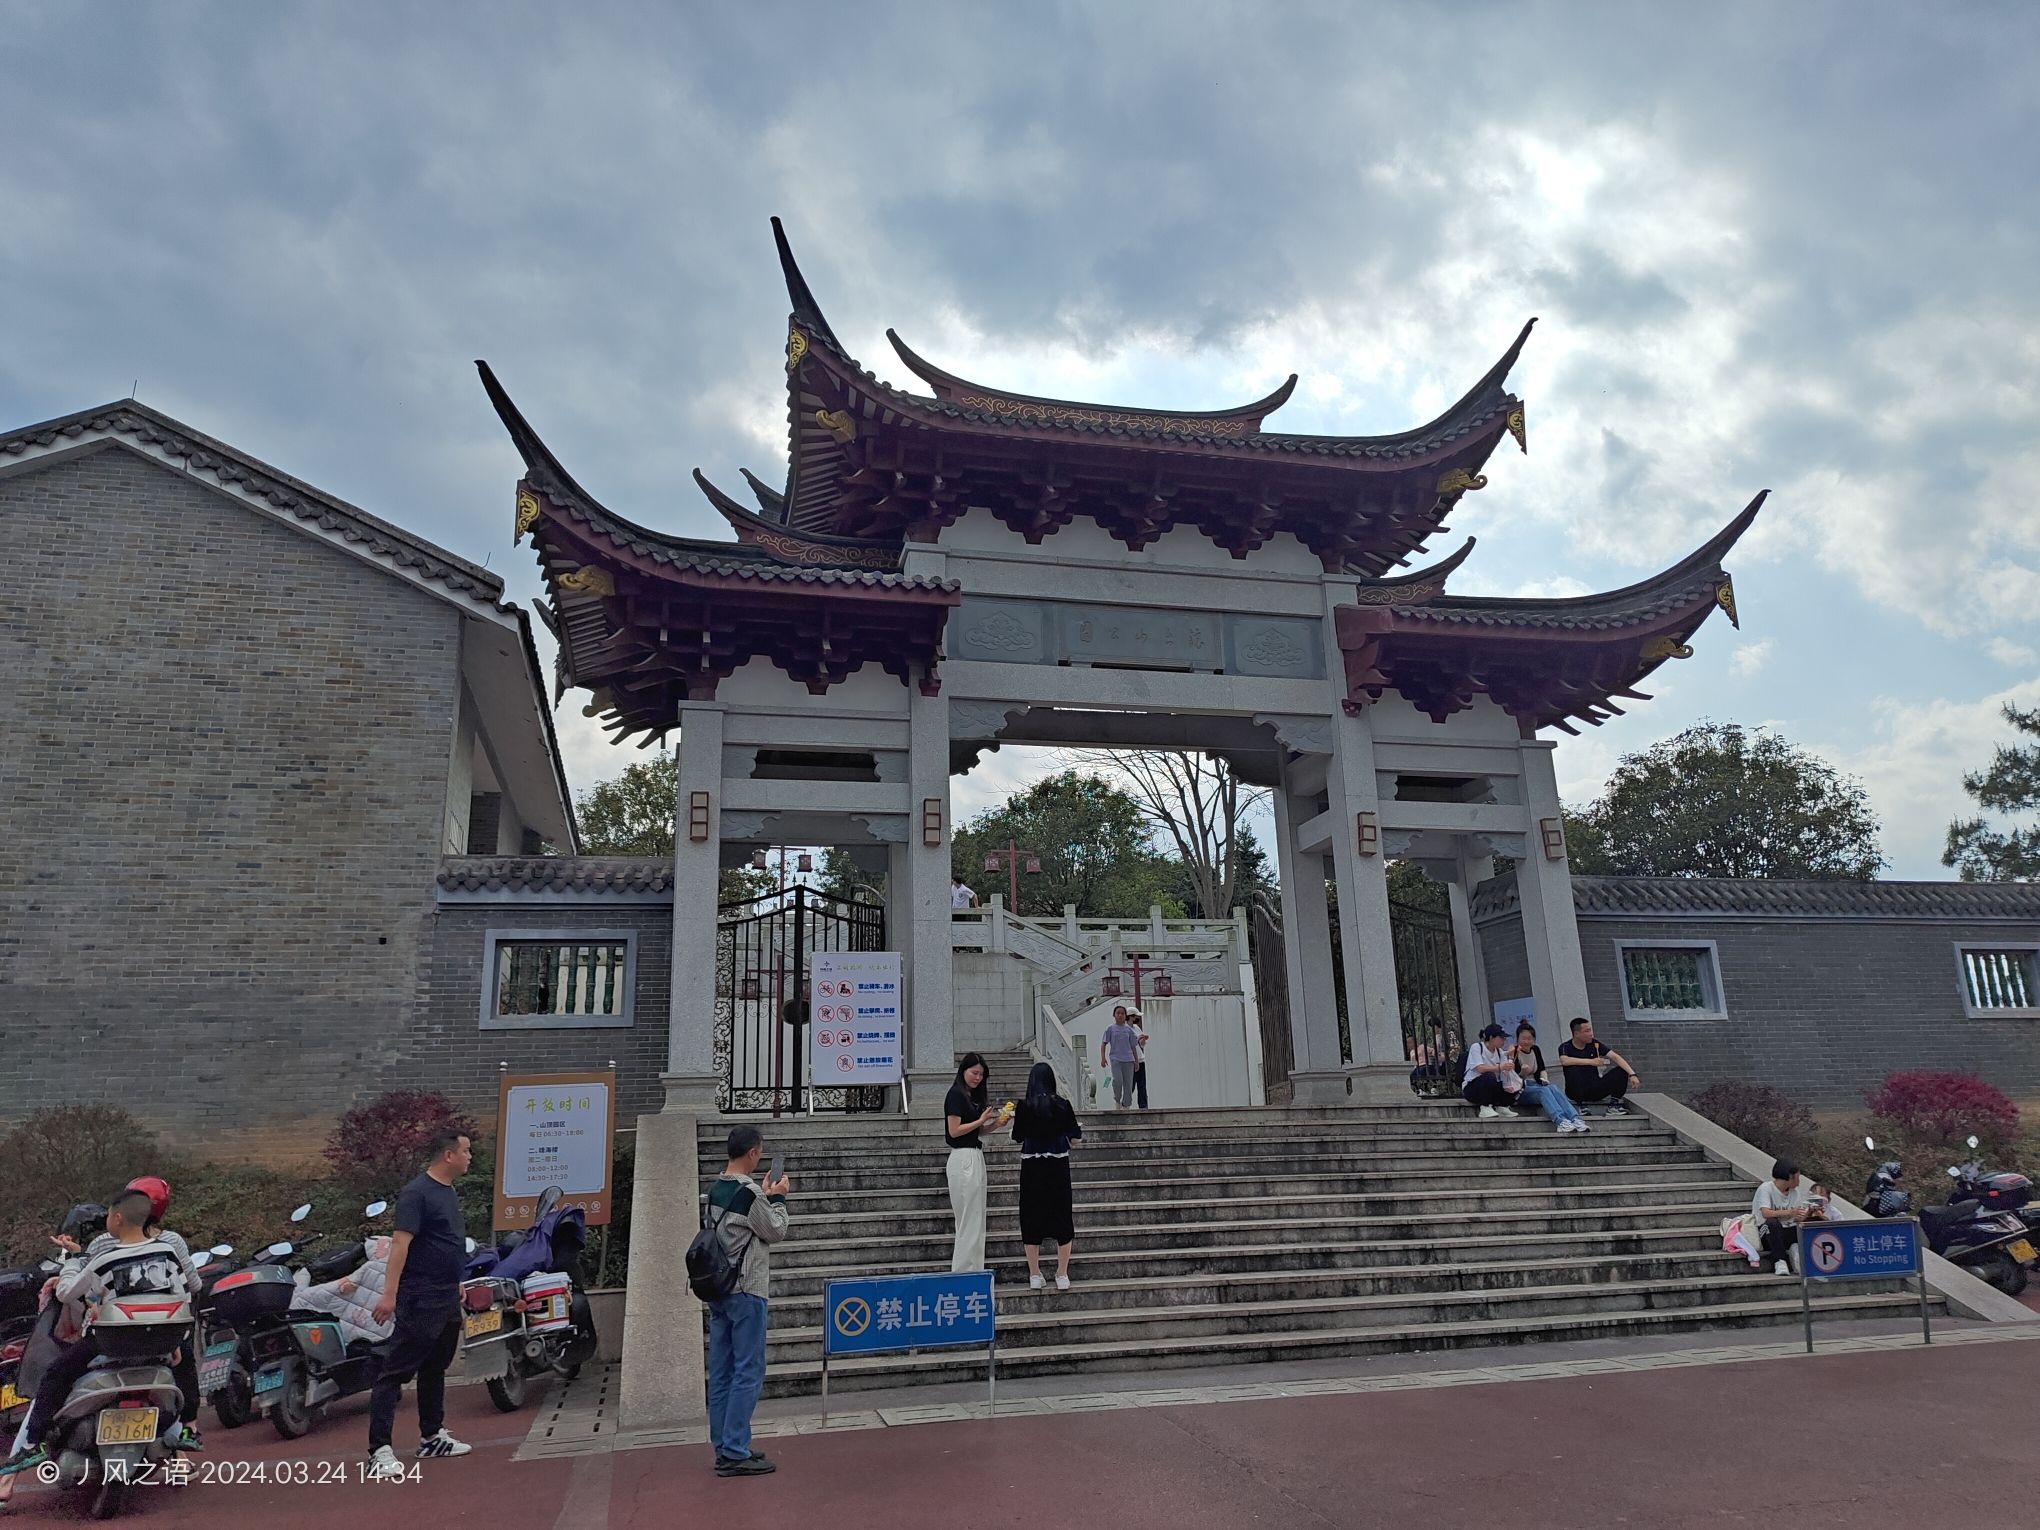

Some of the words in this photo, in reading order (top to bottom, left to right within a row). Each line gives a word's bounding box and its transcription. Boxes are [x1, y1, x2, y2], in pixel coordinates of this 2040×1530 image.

[524, 1097, 591, 1114] 开放时间
[1853, 1234, 1908, 1253] 禁止停车
[1854, 1256, 1866, 1265] No
[1868, 1253, 1908, 1266] Stopping
[876, 1291, 989, 1331] 禁止停车
[103, 1424, 151, 1439] 0316M
